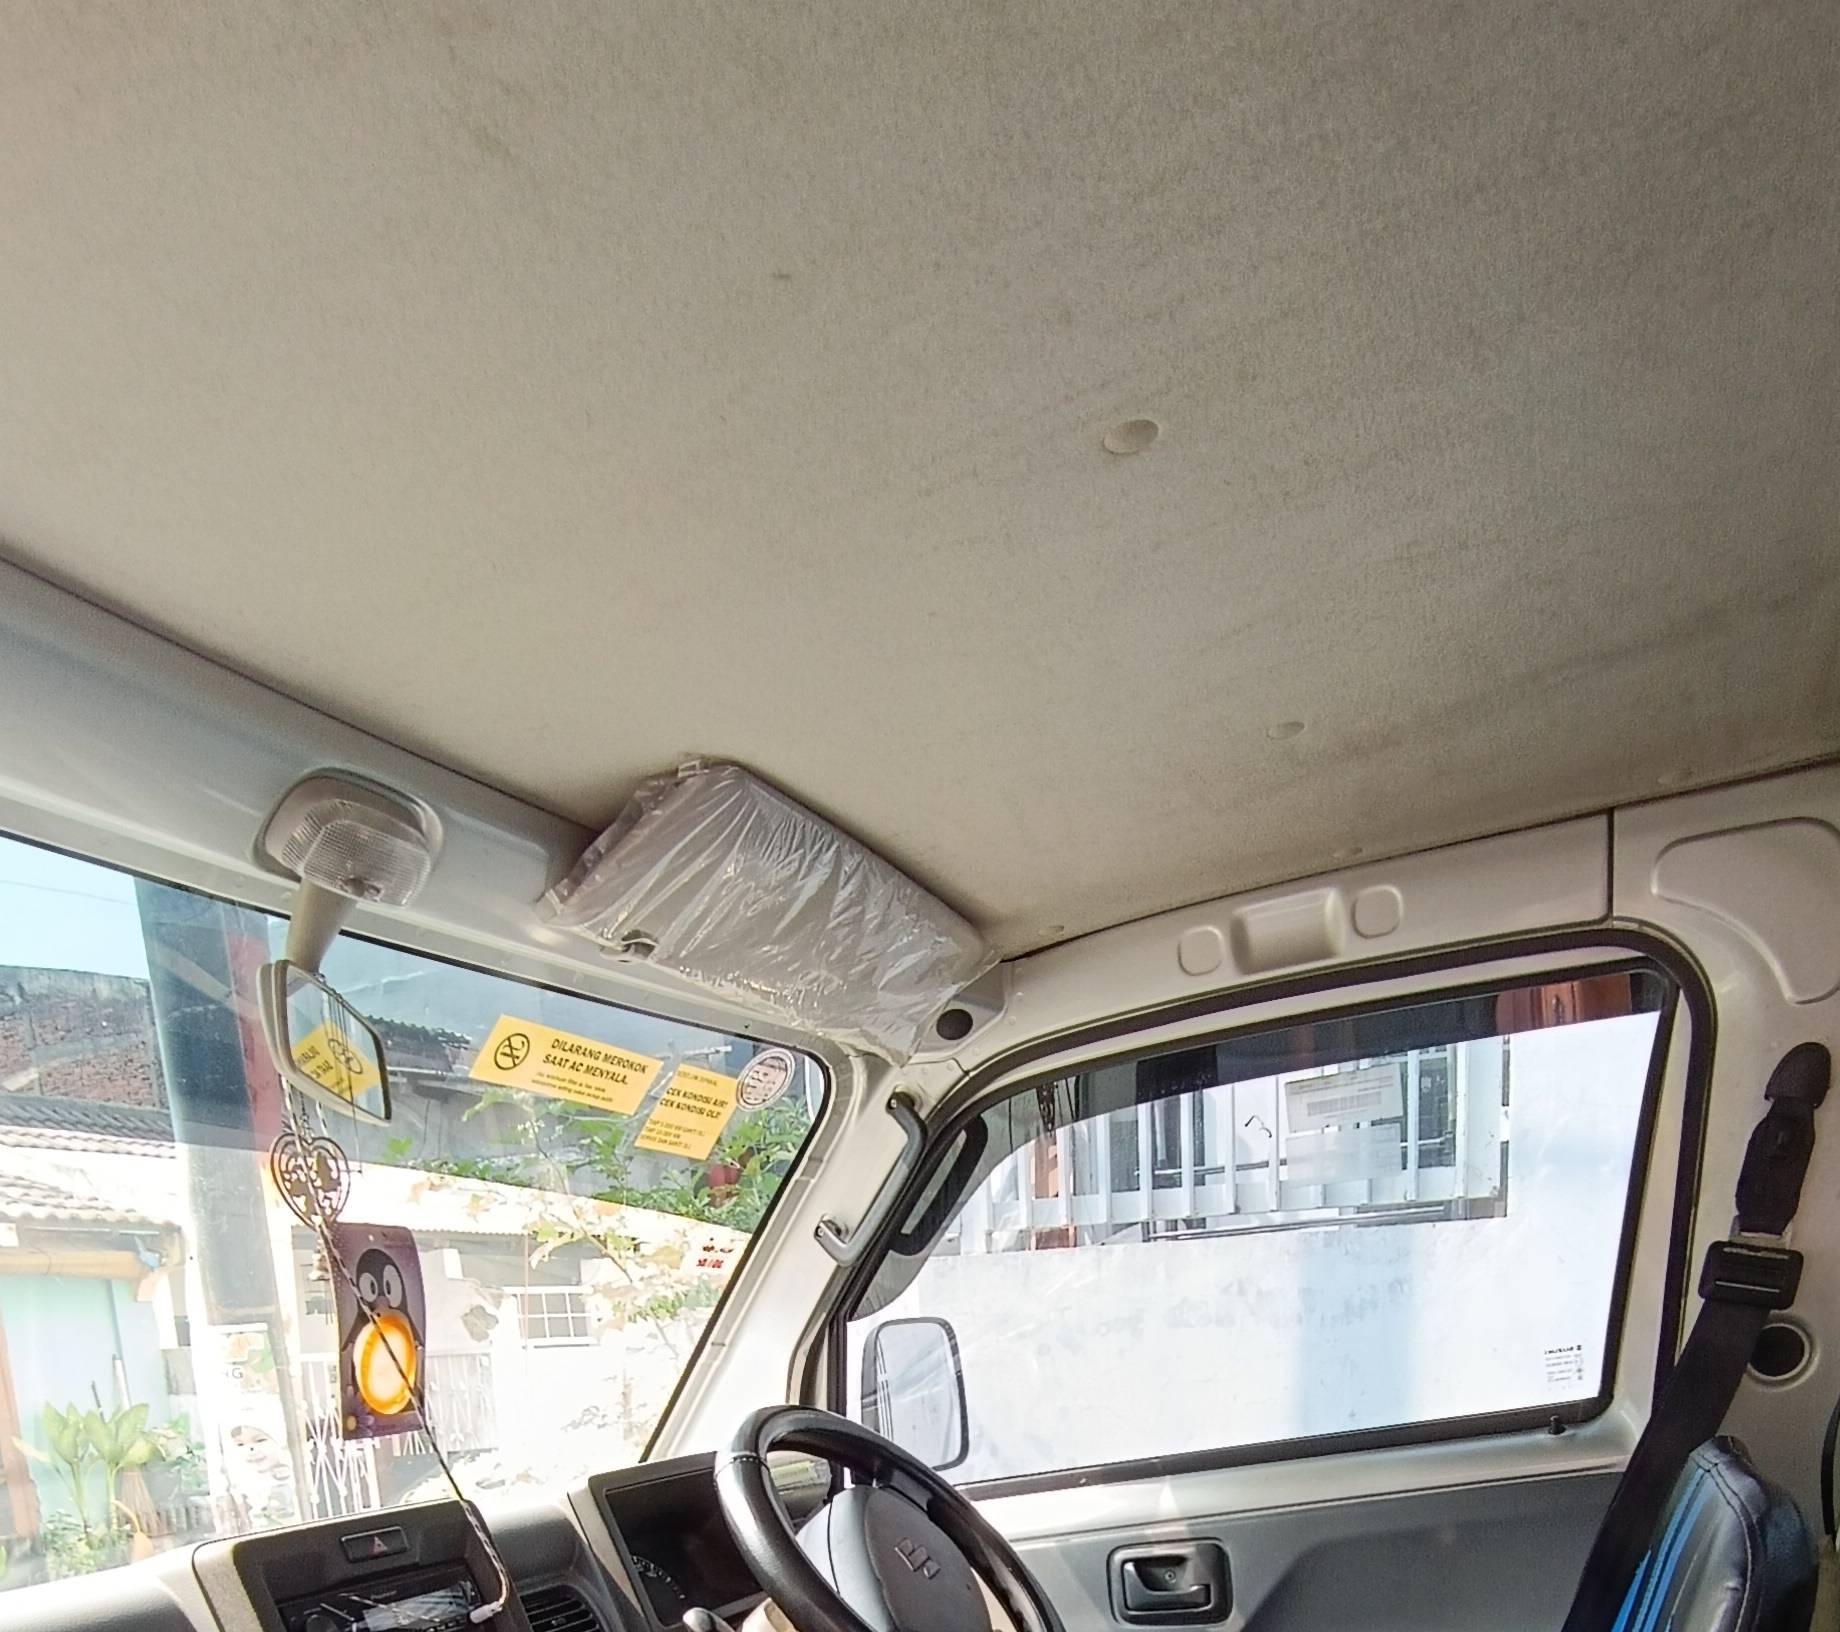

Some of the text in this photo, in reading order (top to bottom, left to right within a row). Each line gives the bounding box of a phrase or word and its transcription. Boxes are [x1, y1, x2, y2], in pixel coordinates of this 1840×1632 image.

[543, 1053, 570, 1069] SAAT
[569, 1060, 584, 1072] AC
[551, 1038, 648, 1074] DILARANG MEROKOK
[666, 1087, 681, 1097] CEK
[682, 1091, 713, 1105] KONDISI
[660, 1097, 675, 1108] CEK
[676, 1101, 706, 1115] KONDISI
